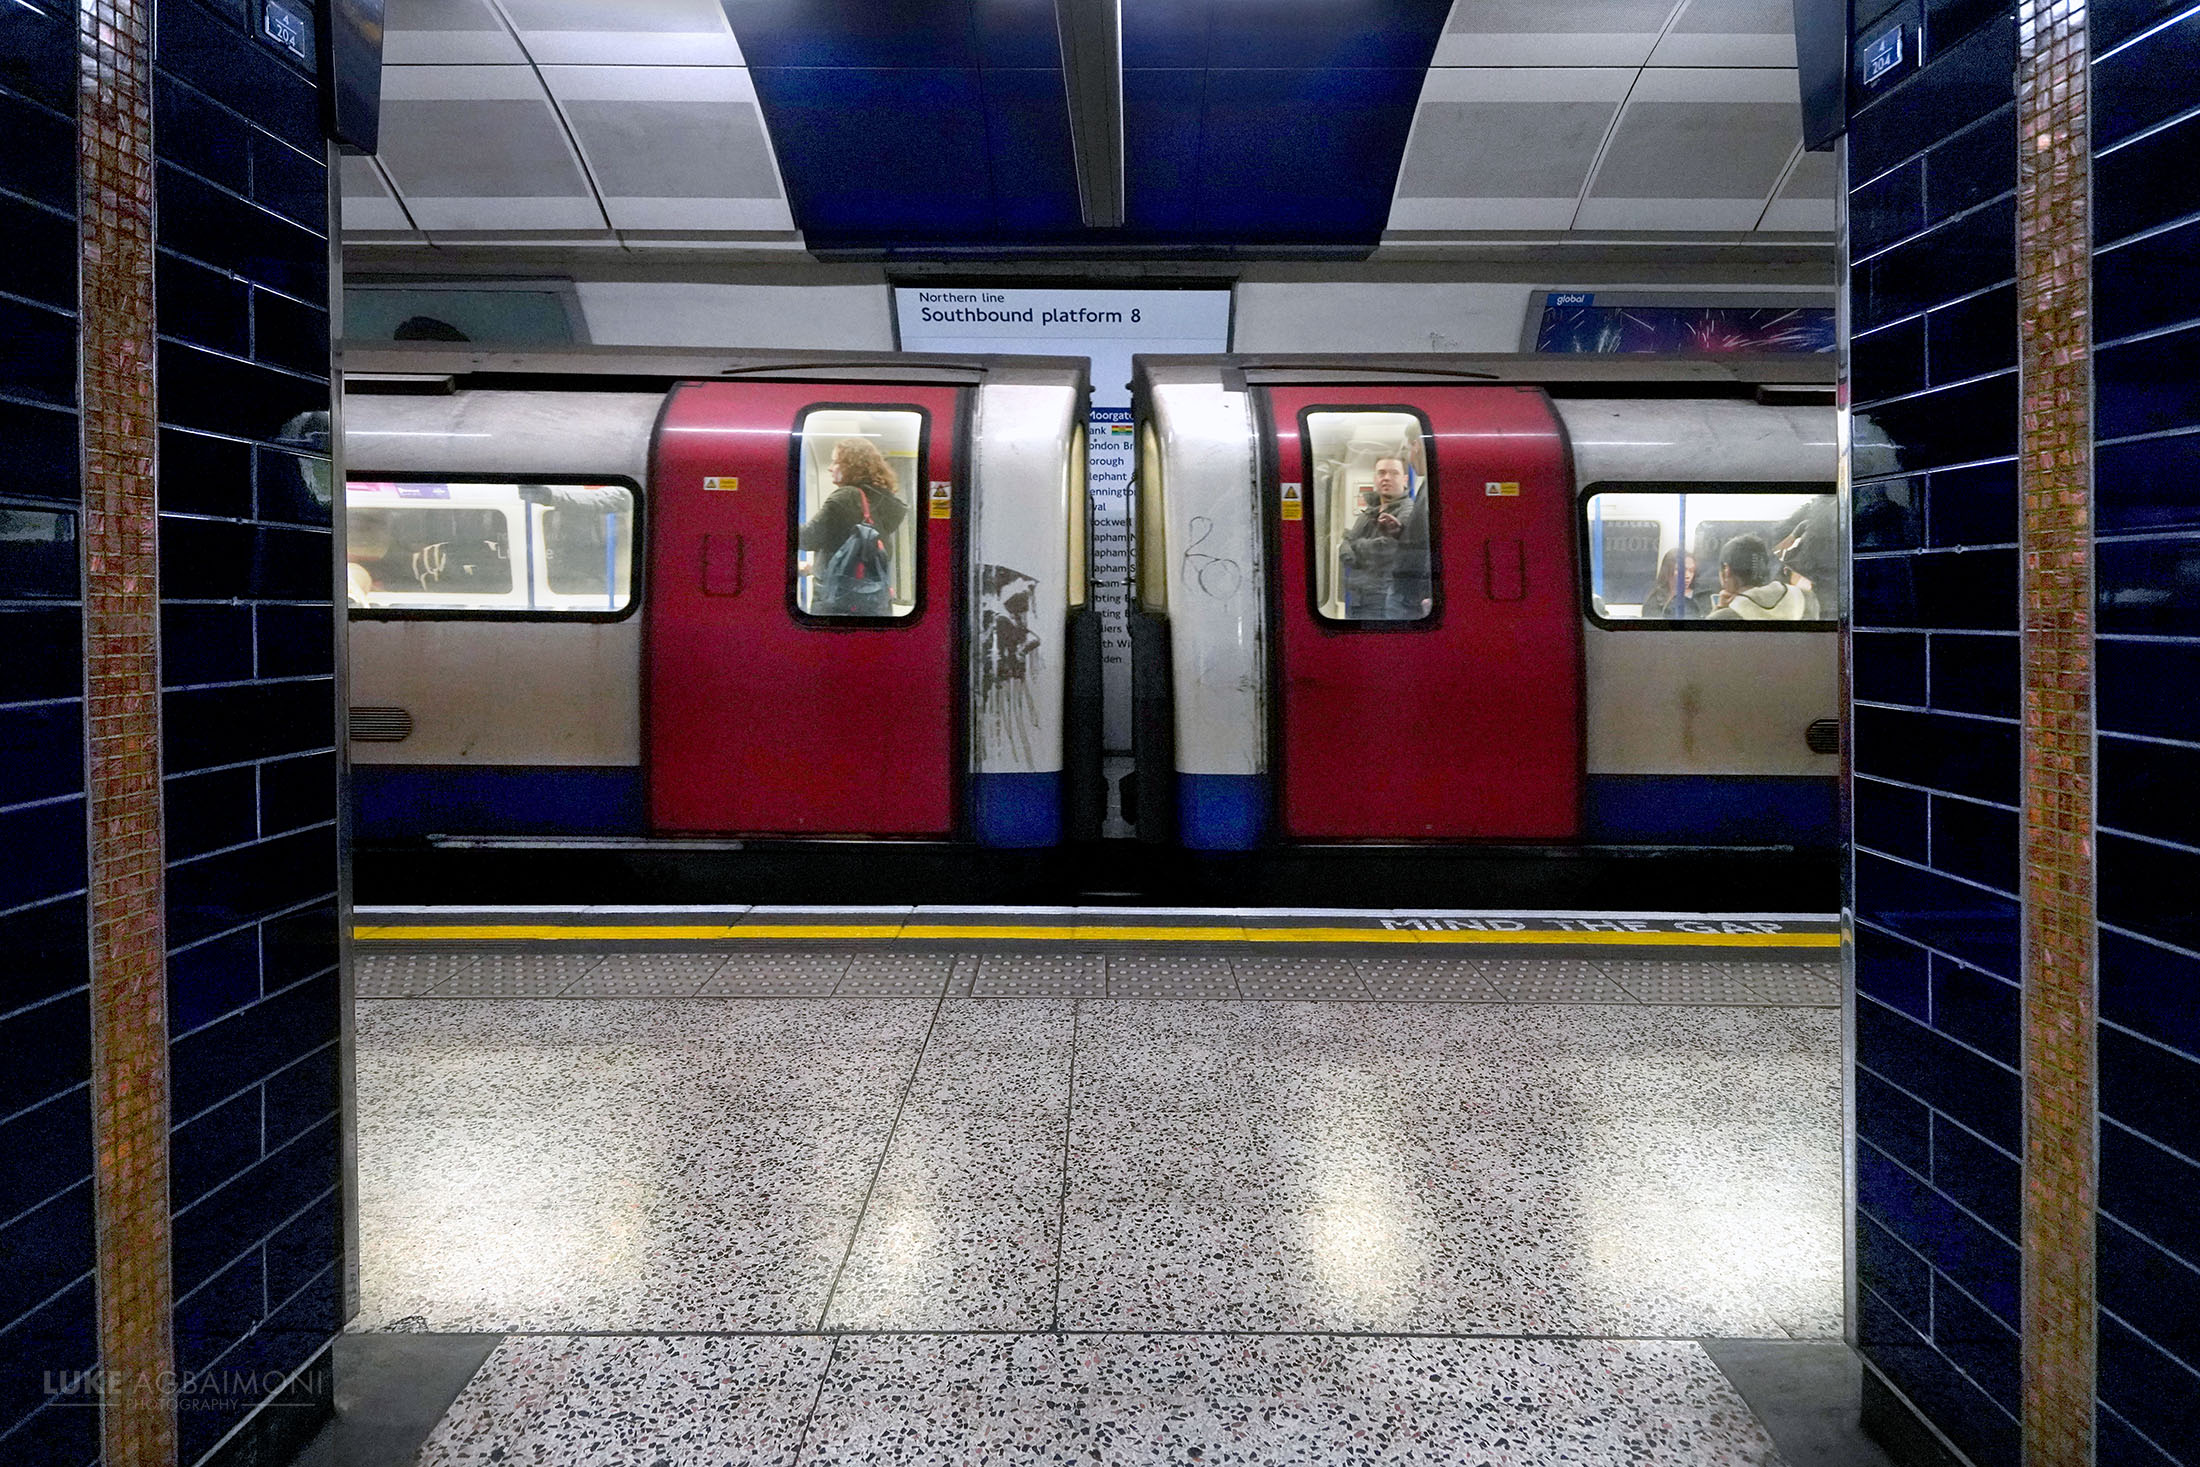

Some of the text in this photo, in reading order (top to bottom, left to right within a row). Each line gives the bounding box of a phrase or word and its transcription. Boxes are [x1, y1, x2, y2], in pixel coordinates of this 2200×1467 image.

[282, 15, 290, 25] 4
[276, 24, 296, 47] 204
[1872, 53, 1891, 75] 204
[919, 292, 1005, 303] Northern line
[1556, 294, 1585, 306] global
[921, 307, 1142, 326] Southbound platform 8
[1089, 426, 1107, 435] ank
[1089, 441, 1120, 450] ondon
[1089, 457, 1124, 467] orough
[1089, 472, 1127, 482] lephant
[1089, 488, 1136, 498] enningto
[1094, 533, 1127, 543] apham
[1094, 548, 1127, 559] apham
[1094, 564, 1127, 574] apham
[1378, 918, 1784, 935] MIND THE GAP
